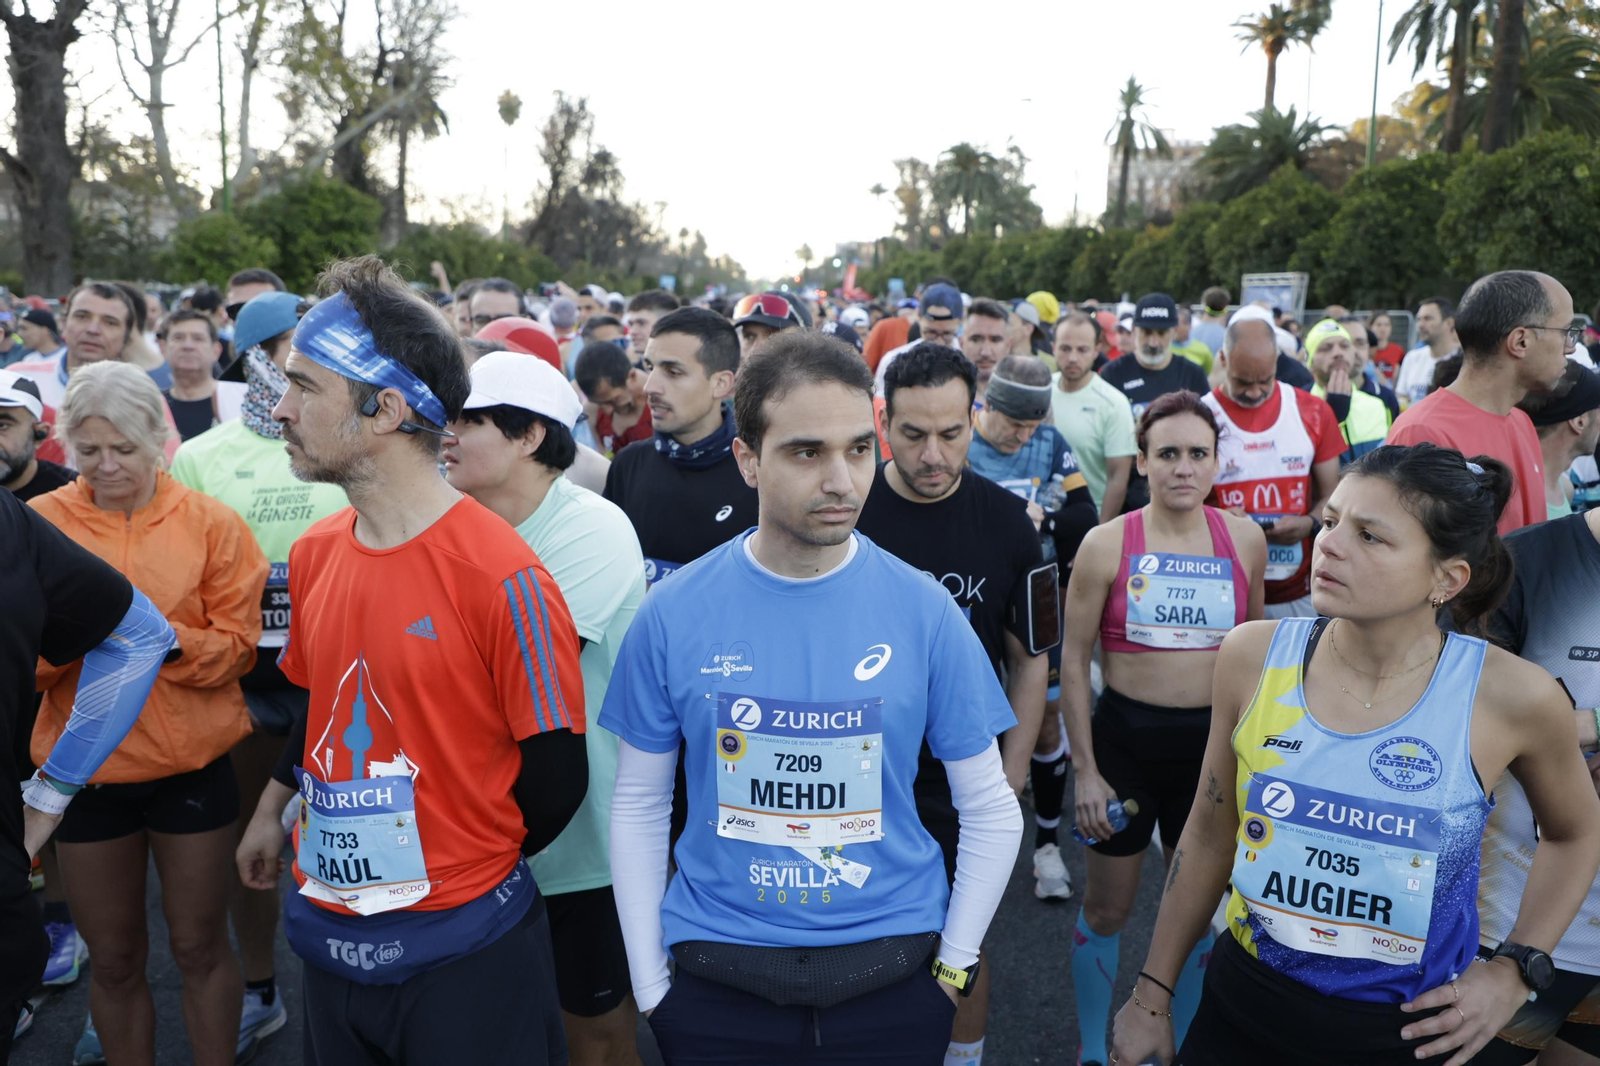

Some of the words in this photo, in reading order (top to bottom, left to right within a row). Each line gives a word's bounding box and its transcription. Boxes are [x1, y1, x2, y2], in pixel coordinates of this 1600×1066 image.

[1141, 307, 1169, 318] HOKA
[1165, 559, 1221, 575] ZURICH
[1166, 587, 1197, 601] 7737
[1155, 605, 1208, 625] SARA
[405, 626, 438, 641] adidas
[730, 664, 753, 672] Sevilla
[772, 709, 863, 730] ZURICH
[764, 736, 790, 745] MARATÓN
[1262, 735, 1304, 752] poli
[1375, 737, 1438, 762] CHARENTON
[773, 753, 822, 773] 7209
[1376, 758, 1436, 774] OLYMPIQUE
[1378, 753, 1434, 767] AZUR
[1372, 767, 1437, 790] ATHLETISME
[314, 786, 393, 810] ZURICH
[750, 778, 847, 810] MEHDI
[1306, 798, 1416, 839] ZURICH
[319, 829, 360, 850] 7733
[1273, 822, 1295, 833] ZURICH
[1295, 828, 1327, 840] MARATÓN
[1327, 834, 1335, 842] DE
[1336, 836, 1360, 847] SEVILLA
[1360, 841, 1376, 850] 2025
[316, 852, 382, 885] RAÚL
[751, 856, 776, 867] ZURICH
[777, 858, 814, 867] MARATÓN
[1304, 846, 1360, 877] 7035
[749, 864, 840, 888] SEVILLA
[1261, 870, 1393, 926] AUGIER
[326, 937, 376, 971] TGC
